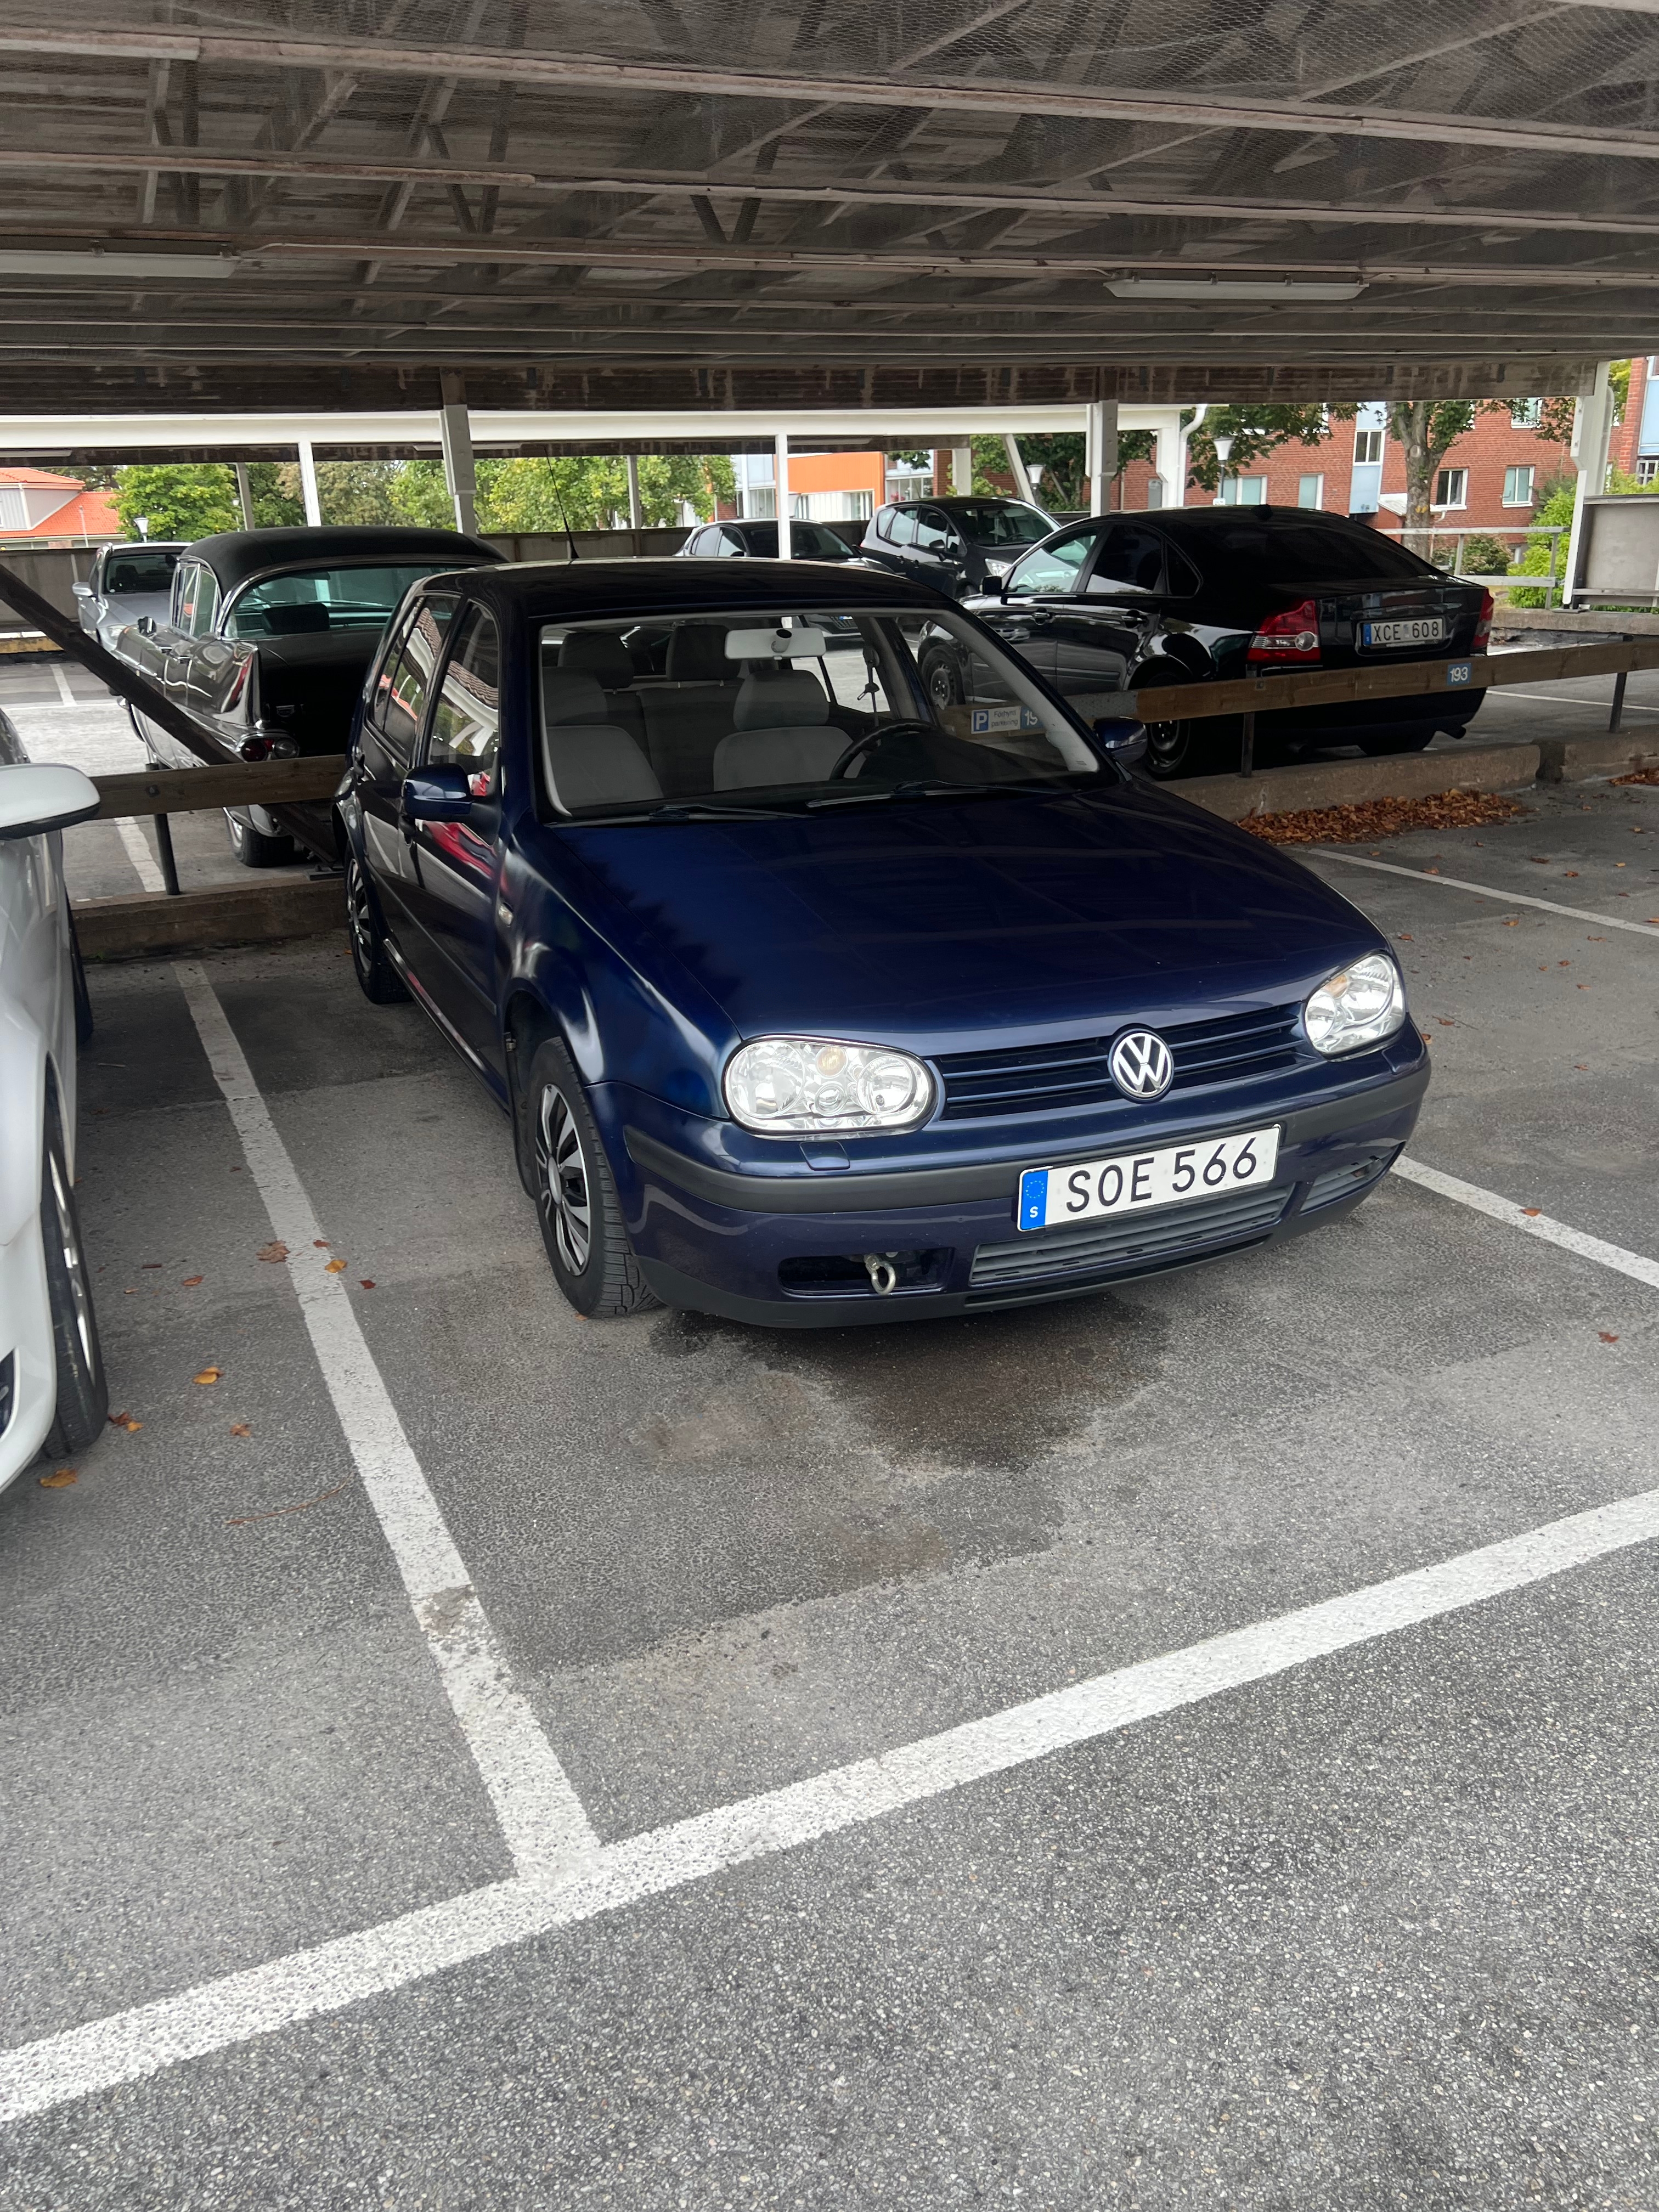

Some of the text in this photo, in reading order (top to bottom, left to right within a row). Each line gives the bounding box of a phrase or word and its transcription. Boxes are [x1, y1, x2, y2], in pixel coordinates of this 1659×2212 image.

[1373, 621, 1438, 641] XCE 608
[1449, 666, 1468, 682] 193
[975, 713, 988, 730] P
[1114, 1034, 1171, 1095] VW
[1066, 1137, 1256, 1212] SOE 566
[1029, 1205, 1039, 1218] S
